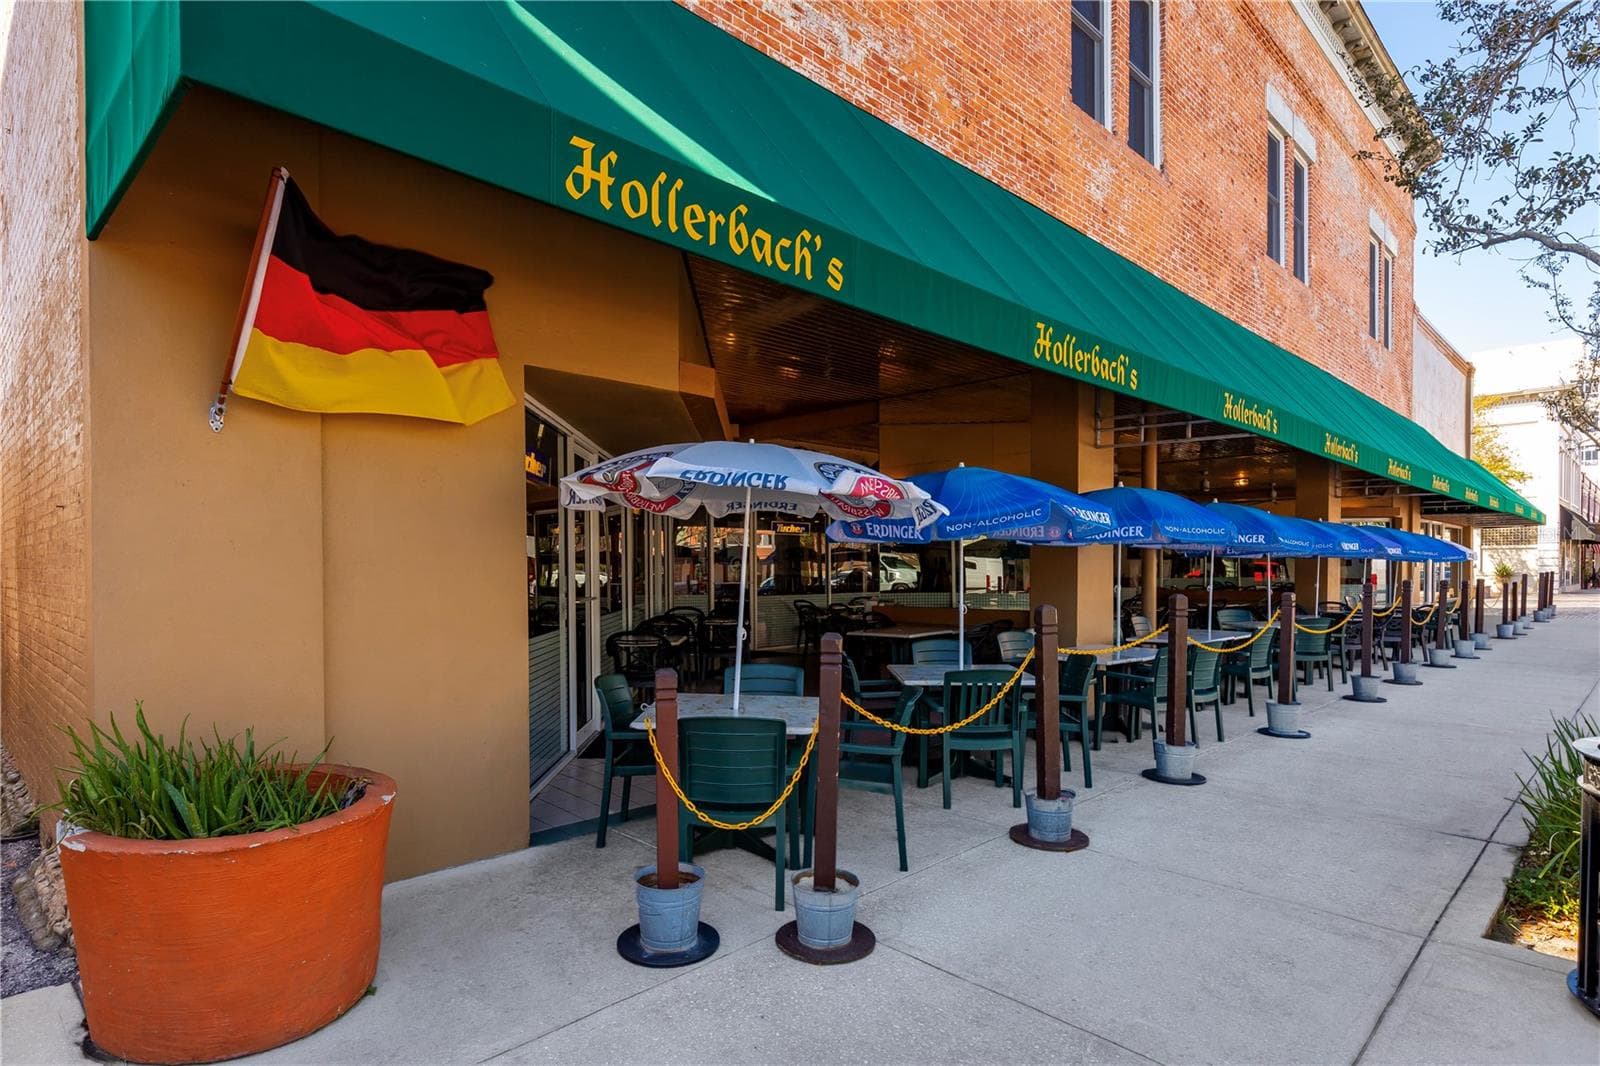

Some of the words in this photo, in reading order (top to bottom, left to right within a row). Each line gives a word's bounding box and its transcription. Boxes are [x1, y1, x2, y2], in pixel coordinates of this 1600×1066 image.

[565, 135, 844, 292] Hollerbach's
[1034, 322, 1138, 391] Hollerbach's
[1223, 392, 1278, 435] Hollerbach's
[866, 522, 924, 541] ERDINGER
[945, 508, 1042, 532] NON-ALCOHOLIC
[1237, 534, 1266, 544] NGER
